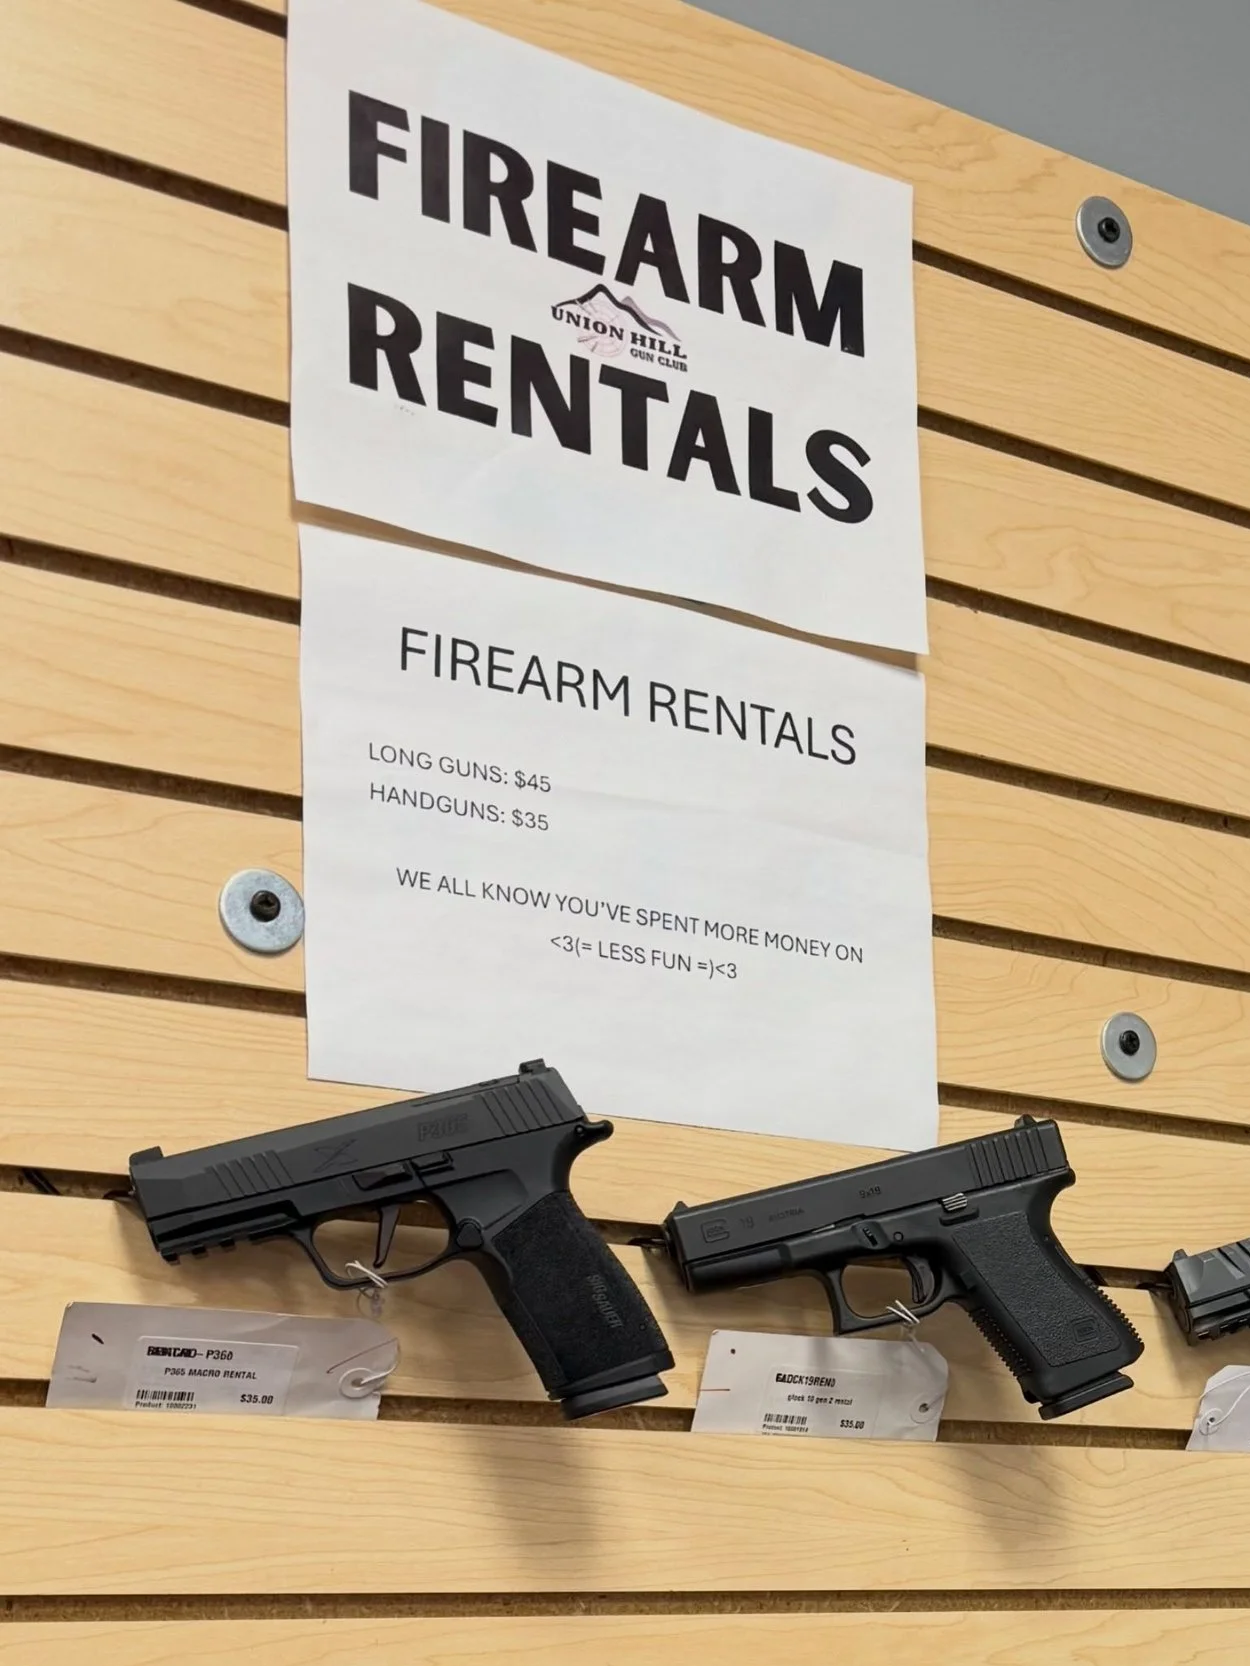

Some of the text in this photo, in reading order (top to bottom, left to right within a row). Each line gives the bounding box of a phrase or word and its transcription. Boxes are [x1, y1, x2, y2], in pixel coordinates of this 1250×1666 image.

[349, 89, 864, 357] FIREARM
[551, 305, 687, 359] UNION HILL
[630, 347, 688, 372] GUN CLUB
[347, 282, 873, 523] RENTALS
[400, 626, 857, 766] FIREARM RENTALS
[368, 742, 552, 794] LONG GUNS: $45
[369, 782, 549, 832] HANDGUNS: $35
[396, 867, 864, 964] WE ALL KNOW YOU'VE SPENT MORE MONEY ON
[599, 940, 646, 967] LESS
[651, 949, 691, 973] FUN
[188, 1368, 221, 1378] MACRO
[223, 1370, 257, 1380] RENTAL
[240, 1394, 274, 1404] $35.00
